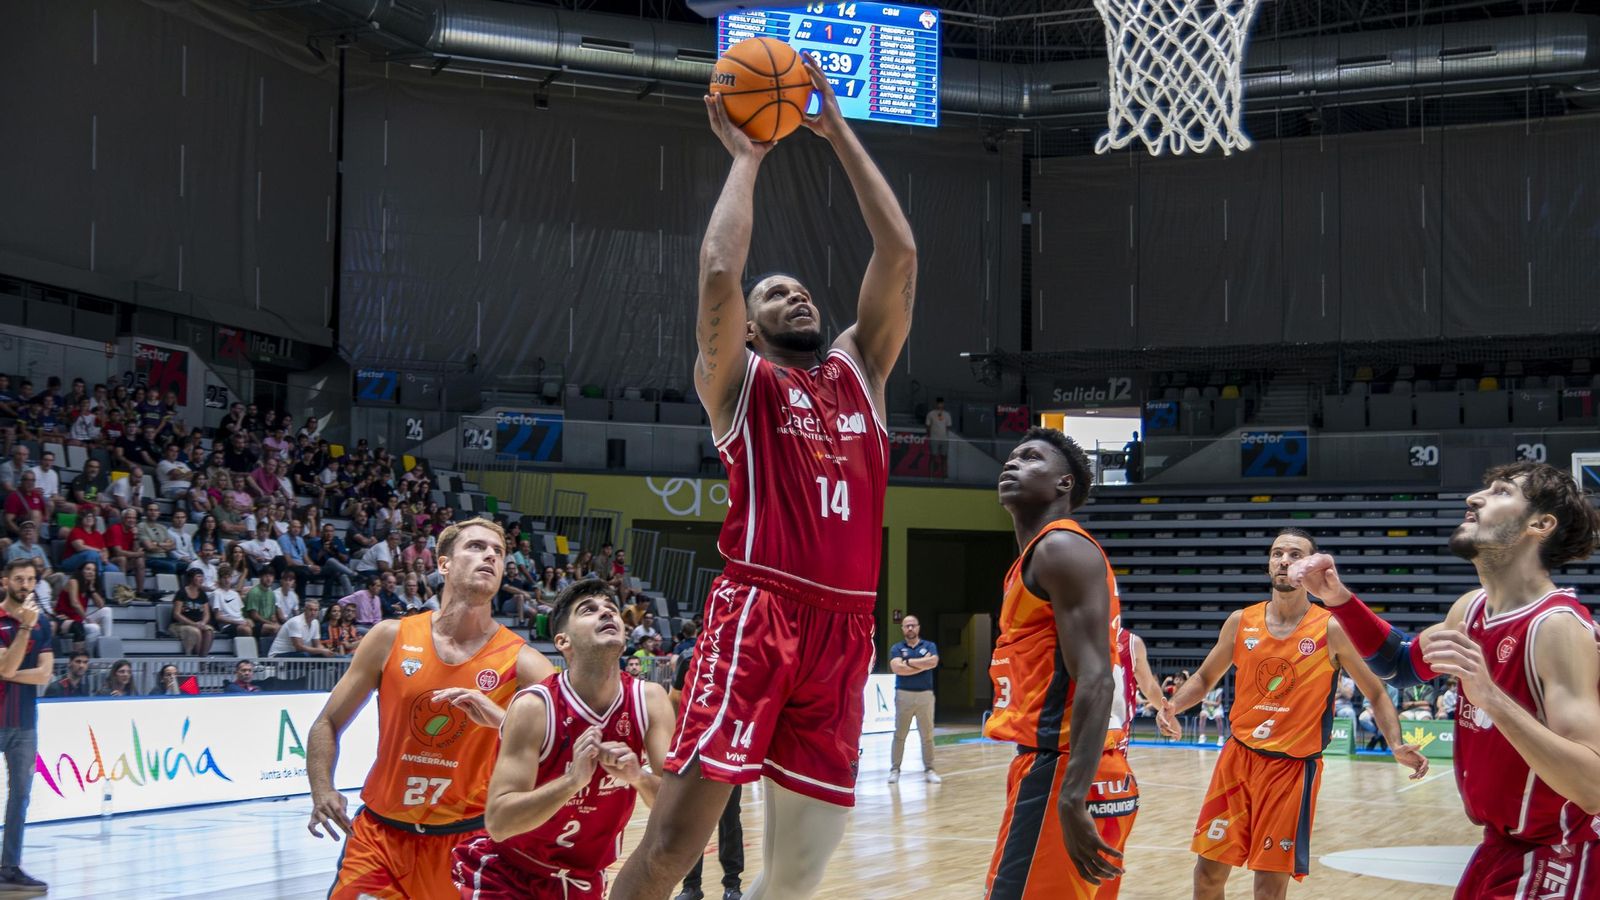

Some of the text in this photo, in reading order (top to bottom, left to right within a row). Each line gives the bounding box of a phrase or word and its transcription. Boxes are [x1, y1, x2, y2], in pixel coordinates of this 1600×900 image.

[838, 3, 856, 18] 14
[882, 8, 900, 16] CBM
[825, 25, 832, 40] 1
[811, 51, 852, 73] 3:39
[846, 80, 855, 96] 1
[135, 343, 171, 362] Sector
[252, 336, 276, 354] lida
[357, 370, 384, 379] Sector
[1052, 377, 1132, 402] Salida 12
[406, 418, 423, 440] 26
[496, 412, 539, 426] Sector
[497, 414, 564, 462] 27
[889, 432, 926, 444] Sector
[1240, 432, 1284, 445] Sector
[1409, 445, 1439, 466] 30
[1516, 443, 1547, 463] 30
[816, 476, 850, 522] 14
[696, 622, 725, 708] Andalucía
[995, 676, 1011, 708] 3
[730, 719, 755, 749] 14
[1252, 719, 1276, 740] 6
[401, 753, 459, 769] AVISERRANO
[403, 776, 452, 806] 27
[556, 820, 581, 848] 2
[1207, 819, 1229, 841] 6
